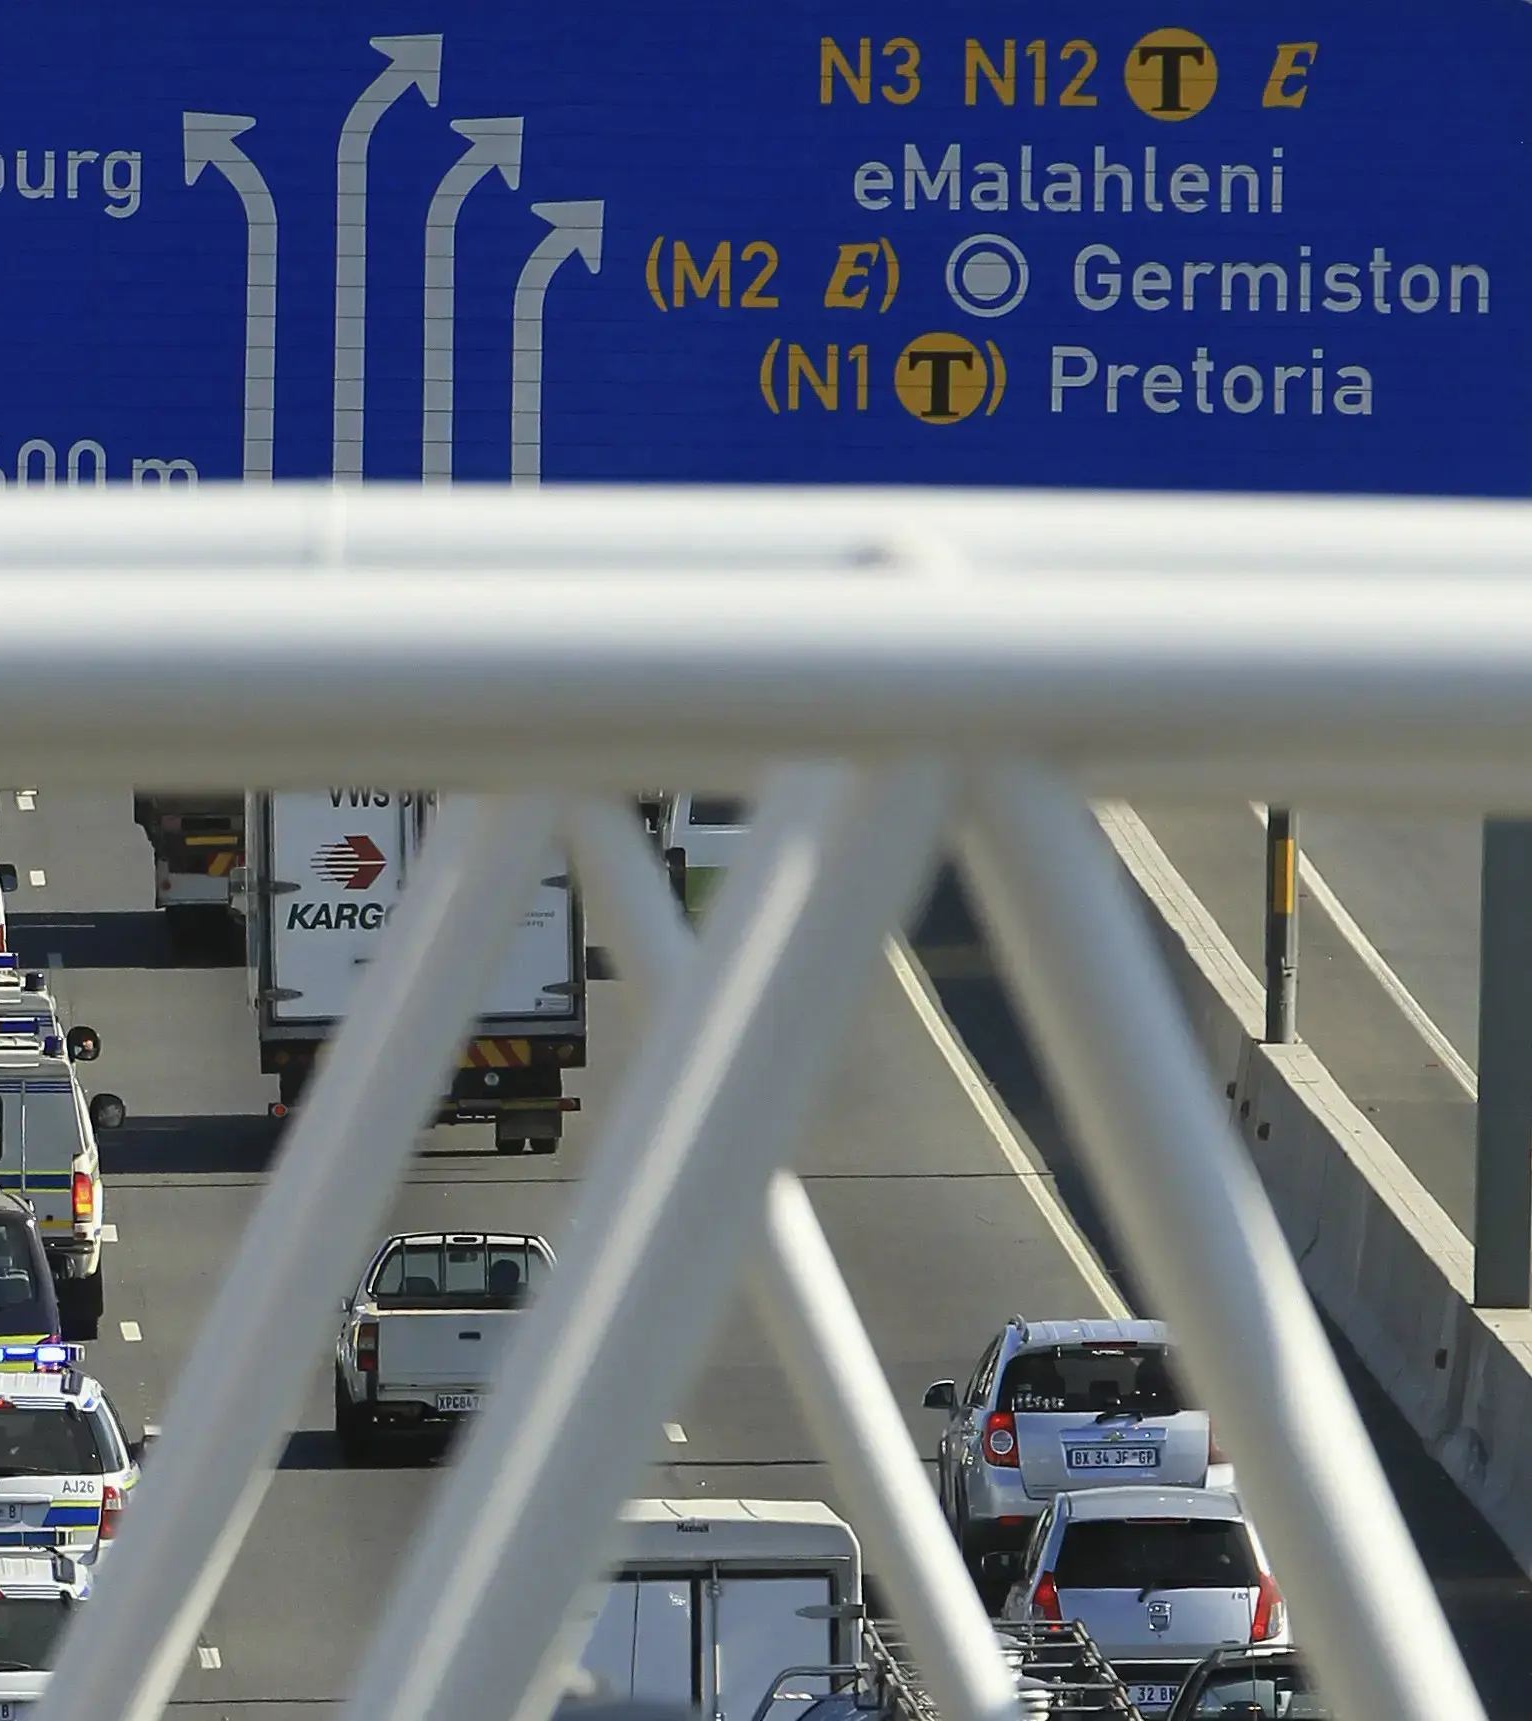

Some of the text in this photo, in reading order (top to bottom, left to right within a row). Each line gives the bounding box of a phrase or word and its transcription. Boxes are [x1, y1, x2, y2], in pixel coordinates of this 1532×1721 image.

[820, 38, 920, 104] N3
[964, 39, 1097, 106] N12
[1262, 42, 1317, 108] E
[854, 144, 1284, 213] eMalahleni
[645, 236, 1490, 314] (M2 E) Germiston
[760, 338, 868, 415] (N1
[1051, 346, 1373, 415] Pretoria
[61, 1480, 95, 1494] AJ26
[1139, 1450, 1154, 1465] GP
[1137, 1687, 1154, 1701] 32
